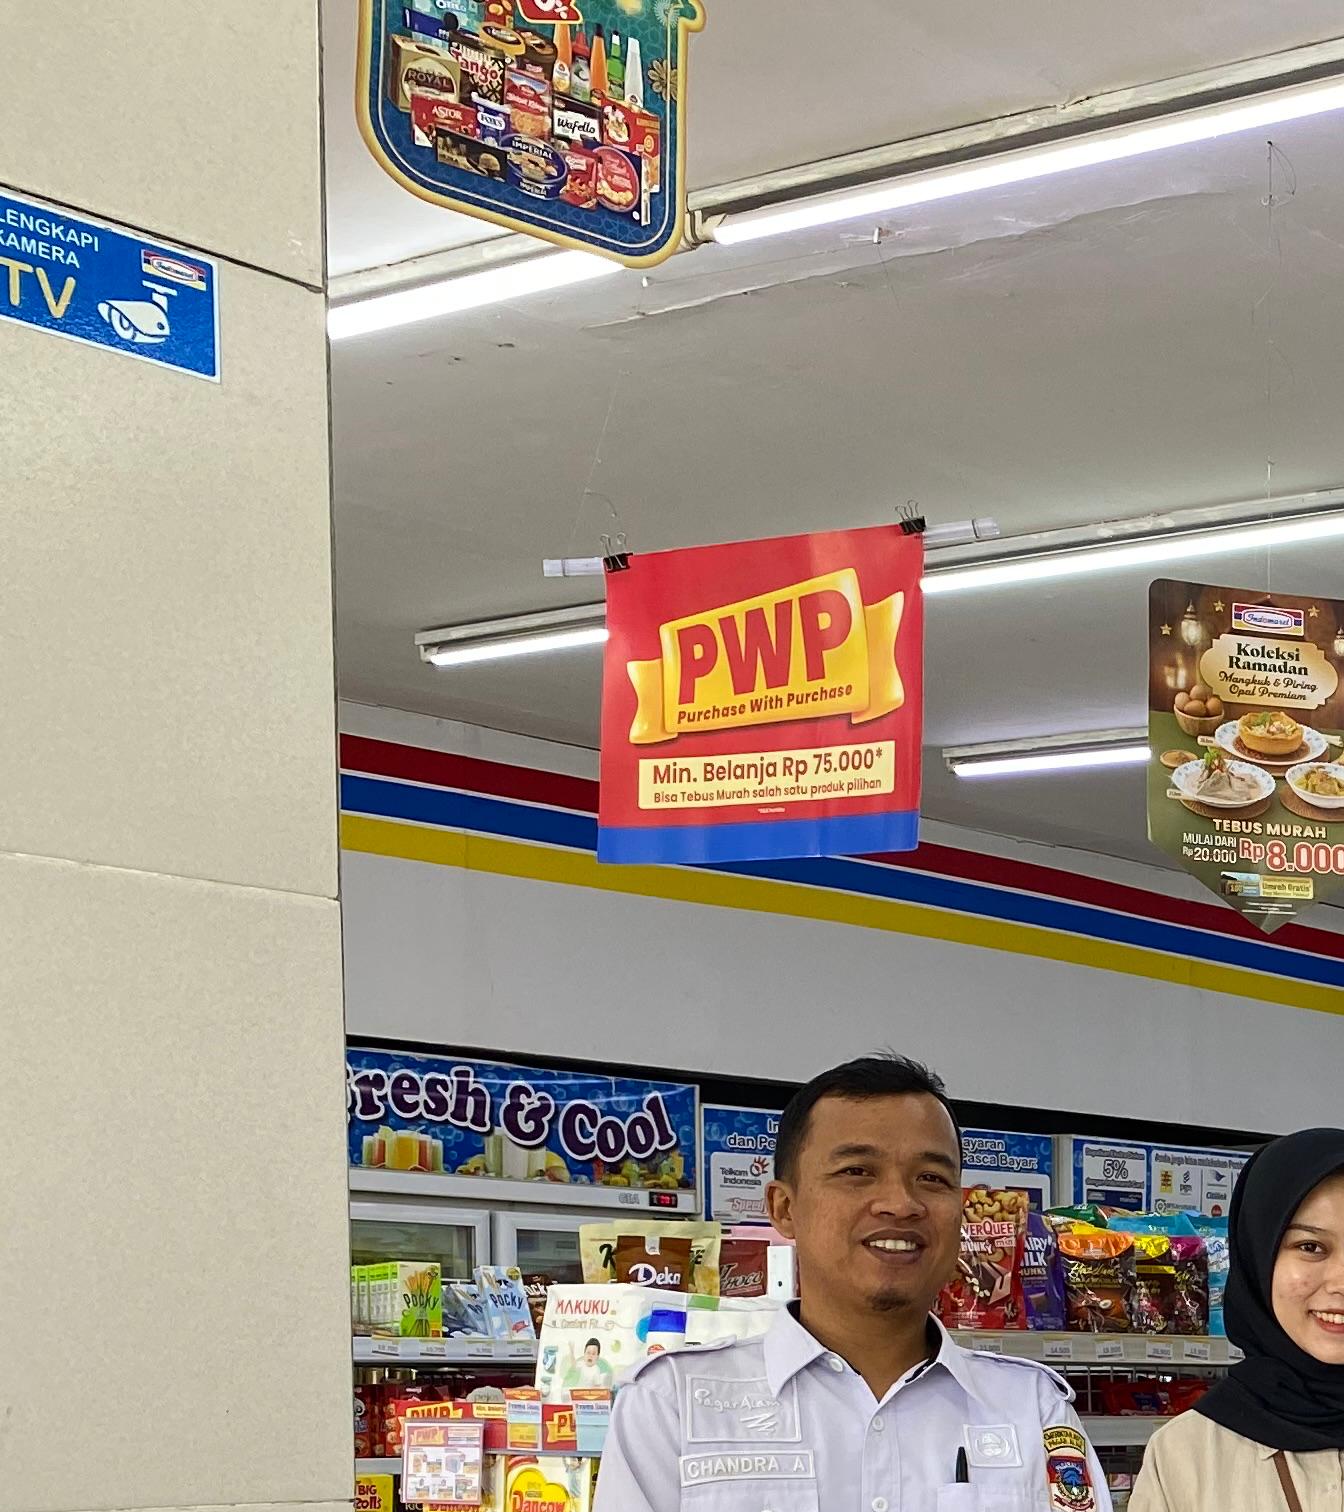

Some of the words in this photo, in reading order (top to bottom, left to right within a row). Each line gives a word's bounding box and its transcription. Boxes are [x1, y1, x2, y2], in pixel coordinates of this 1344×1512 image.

[451, 49, 499, 85] Tango
[408, 70, 450, 89] ROYAL
[557, 117, 596, 134] Wafello
[677, 589, 853, 705] PWP
[1236, 643, 1300, 662] Koleksi
[1228, 656, 1308, 676] Ramadan
[677, 703, 745, 725] Purchase
[750, 697, 783, 713] With
[786, 683, 853, 707] Purchase
[653, 761, 698, 785] Min.
[703, 756, 777, 786] Belanja
[782, 756, 808, 783] Rp
[654, 791, 678, 803] Bisa
[681, 790, 714, 803] Tebus
[716, 788, 750, 801] Murah
[752, 785, 782, 798] salah
[783, 784, 808, 796] satu
[810, 781, 844, 796] produk
[847, 778, 881, 792] pilihan
[1213, 818, 1263, 835] TEBUS
[1266, 821, 1327, 839] MURAH
[348, 1065, 492, 1133] resh
[502, 1081, 555, 1146] &
[559, 1091, 677, 1162] Cool
[1103, 1159, 1128, 1179] 5%
[723, 1176, 762, 1186] Indonesia
[628, 1263, 683, 1287] Deka
[402, 1292, 441, 1310] POCKY
[555, 1298, 610, 1316] MAKUKU
[687, 1455, 779, 1479] CHANDRA
[792, 1455, 806, 1473] A
